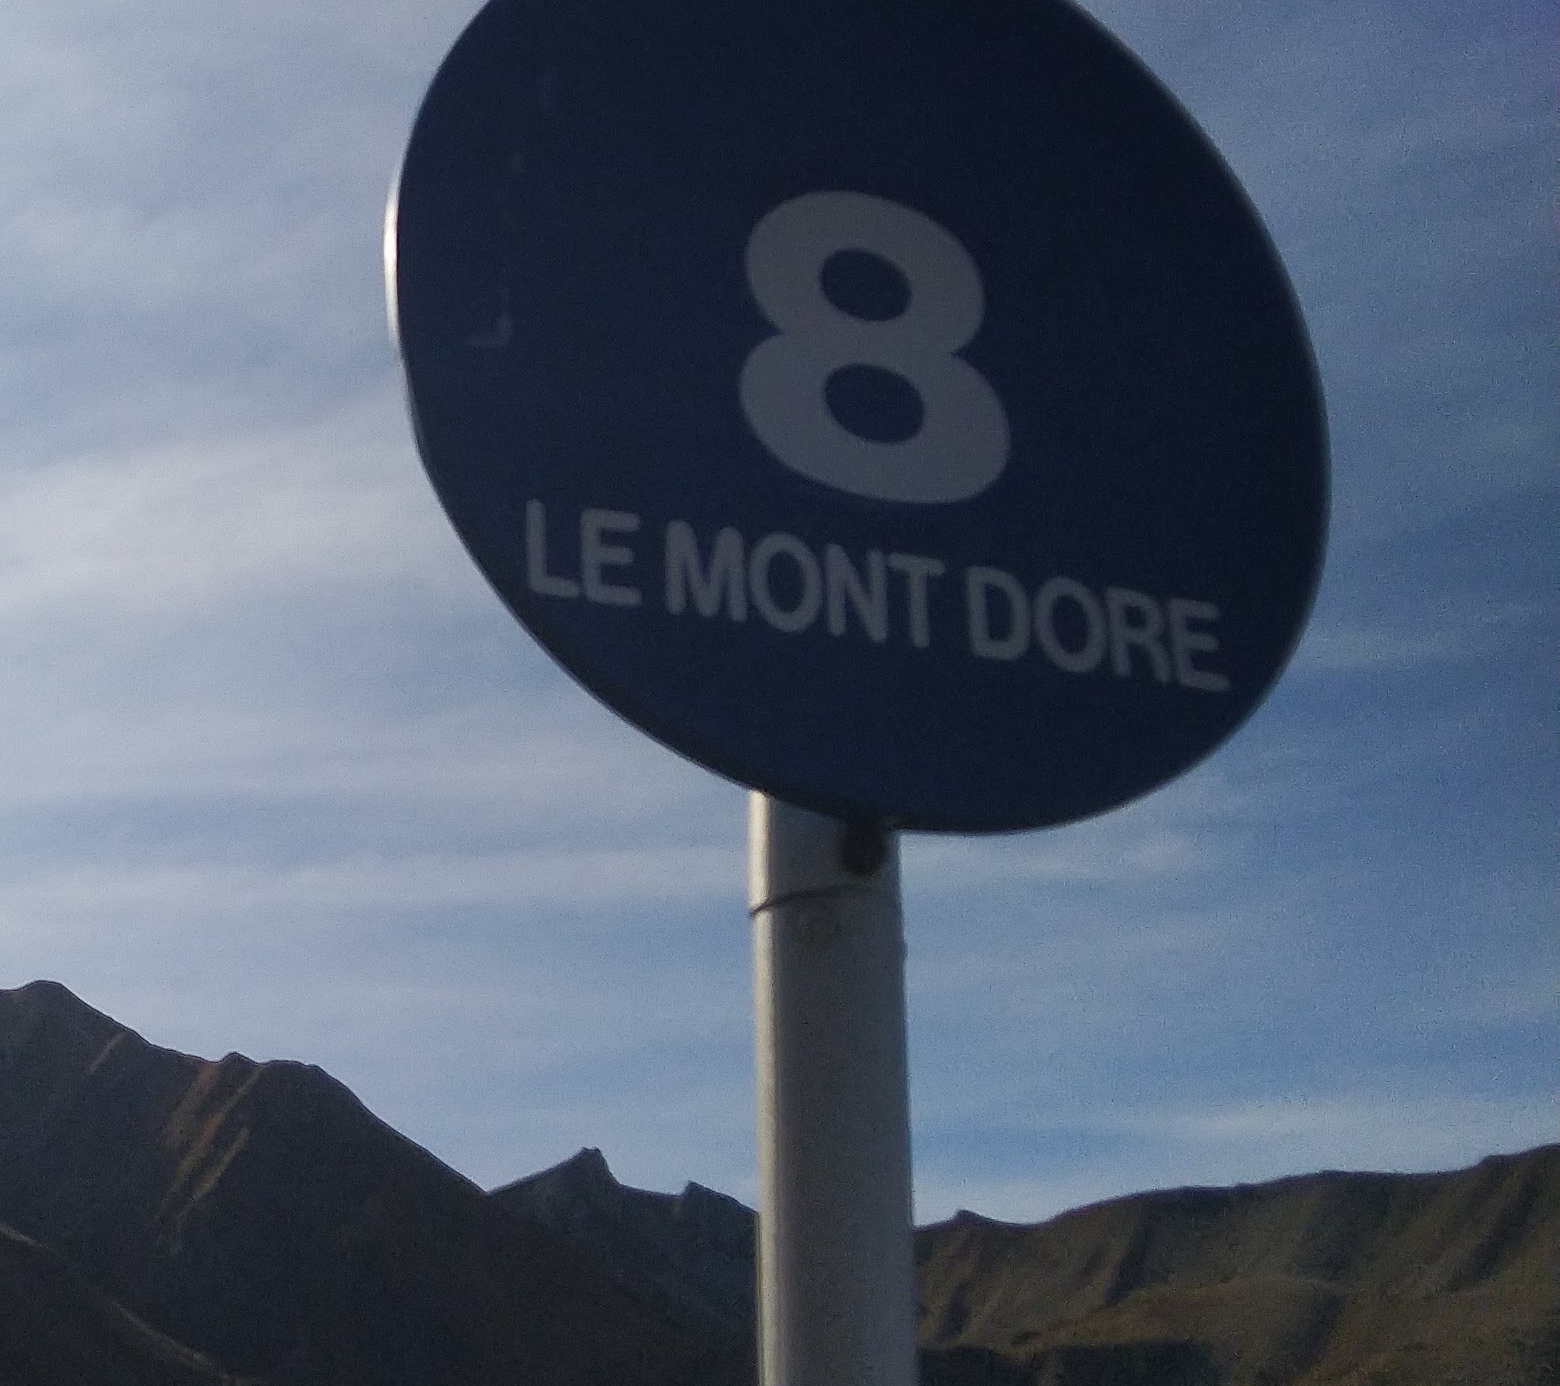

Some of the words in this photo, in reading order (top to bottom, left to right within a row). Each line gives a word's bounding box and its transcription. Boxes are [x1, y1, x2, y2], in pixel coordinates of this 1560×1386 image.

[739, 190, 1011, 504] 8
[525, 499, 641, 606] LE
[665, 519, 945, 649] MONT
[966, 565, 1231, 693] DORE
